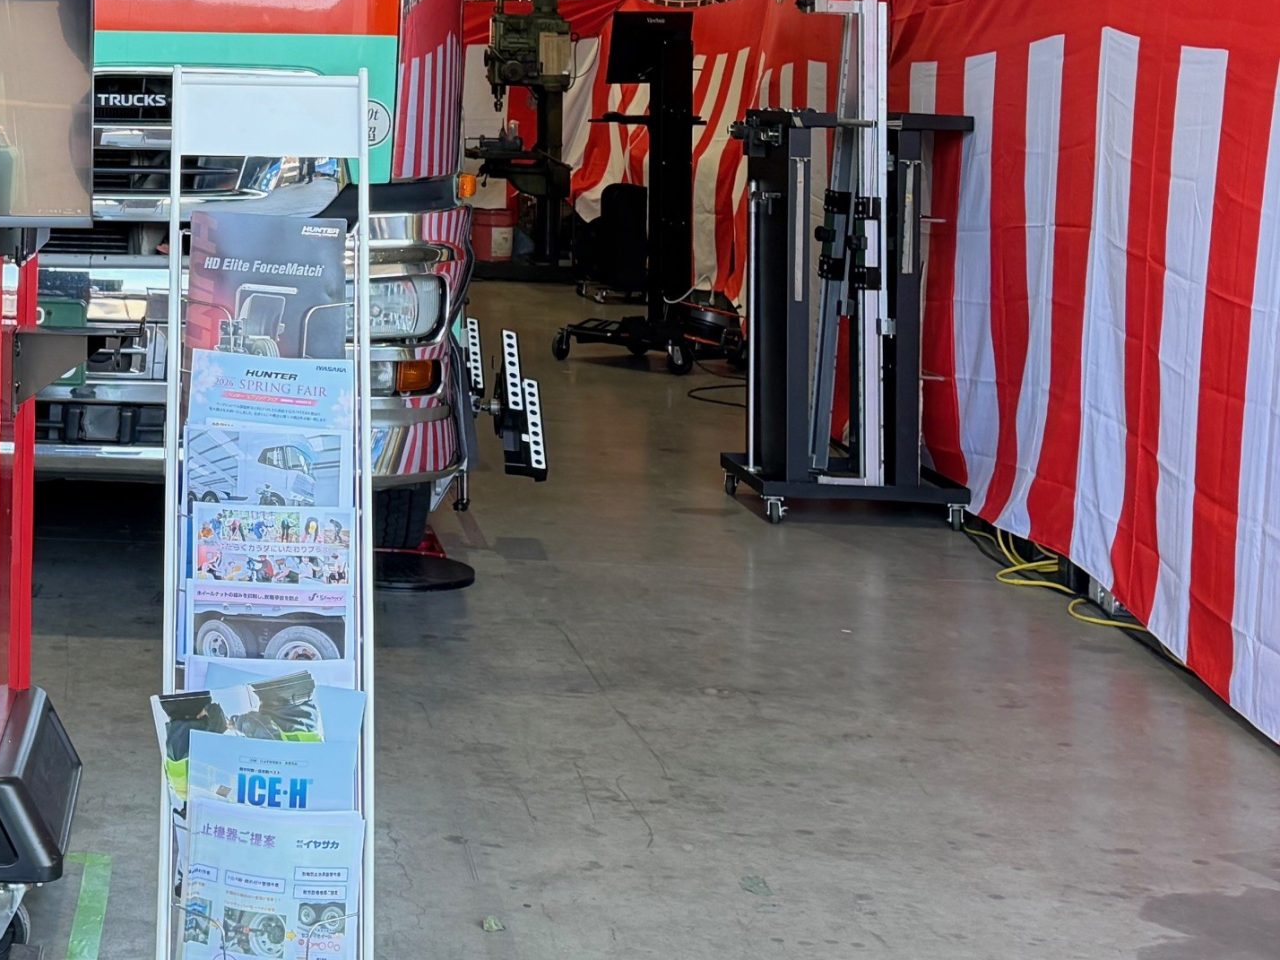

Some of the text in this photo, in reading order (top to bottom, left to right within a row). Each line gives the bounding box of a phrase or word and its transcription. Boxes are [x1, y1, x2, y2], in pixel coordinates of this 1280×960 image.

[97, 93, 166, 107] TRUCKS
[301, 225, 340, 236] HUNTER
[204, 257, 324, 276] HD Elite ForceMatch
[246, 369, 298, 381] HUNTER
[239, 379, 291, 393] SPRING
[296, 385, 328, 397] FAIR
[304, 839, 340, 851] イヤサカ
